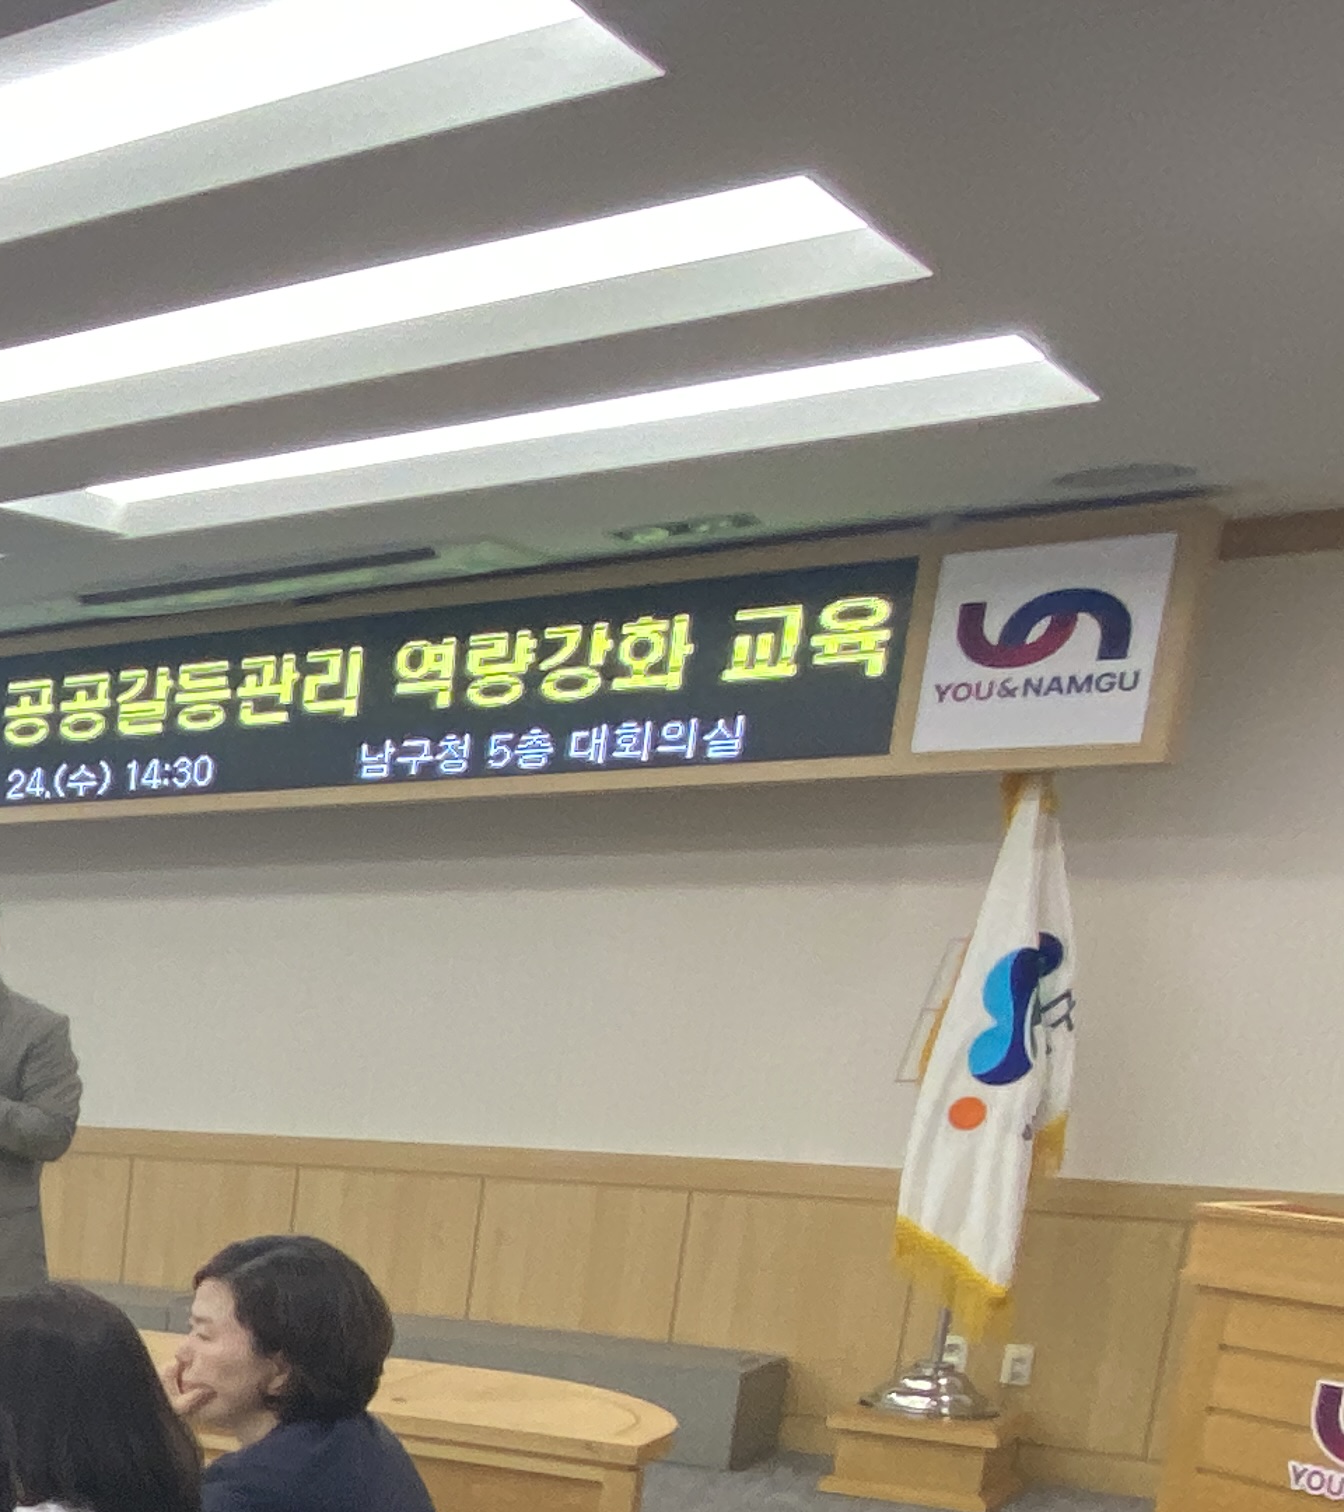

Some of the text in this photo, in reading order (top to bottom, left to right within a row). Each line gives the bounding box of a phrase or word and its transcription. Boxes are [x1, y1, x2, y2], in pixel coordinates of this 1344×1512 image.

[3, 647, 364, 748] 공공갈등관리
[394, 613, 696, 711] 역량강화
[720, 596, 894, 684] 교육
[935, 669, 1142, 703] YOU&NAMGU
[359, 714, 746, 779] 남구청 5층 대회의실
[5, 759, 112, 800] 24.(수)
[126, 754, 215, 792] 14:30
